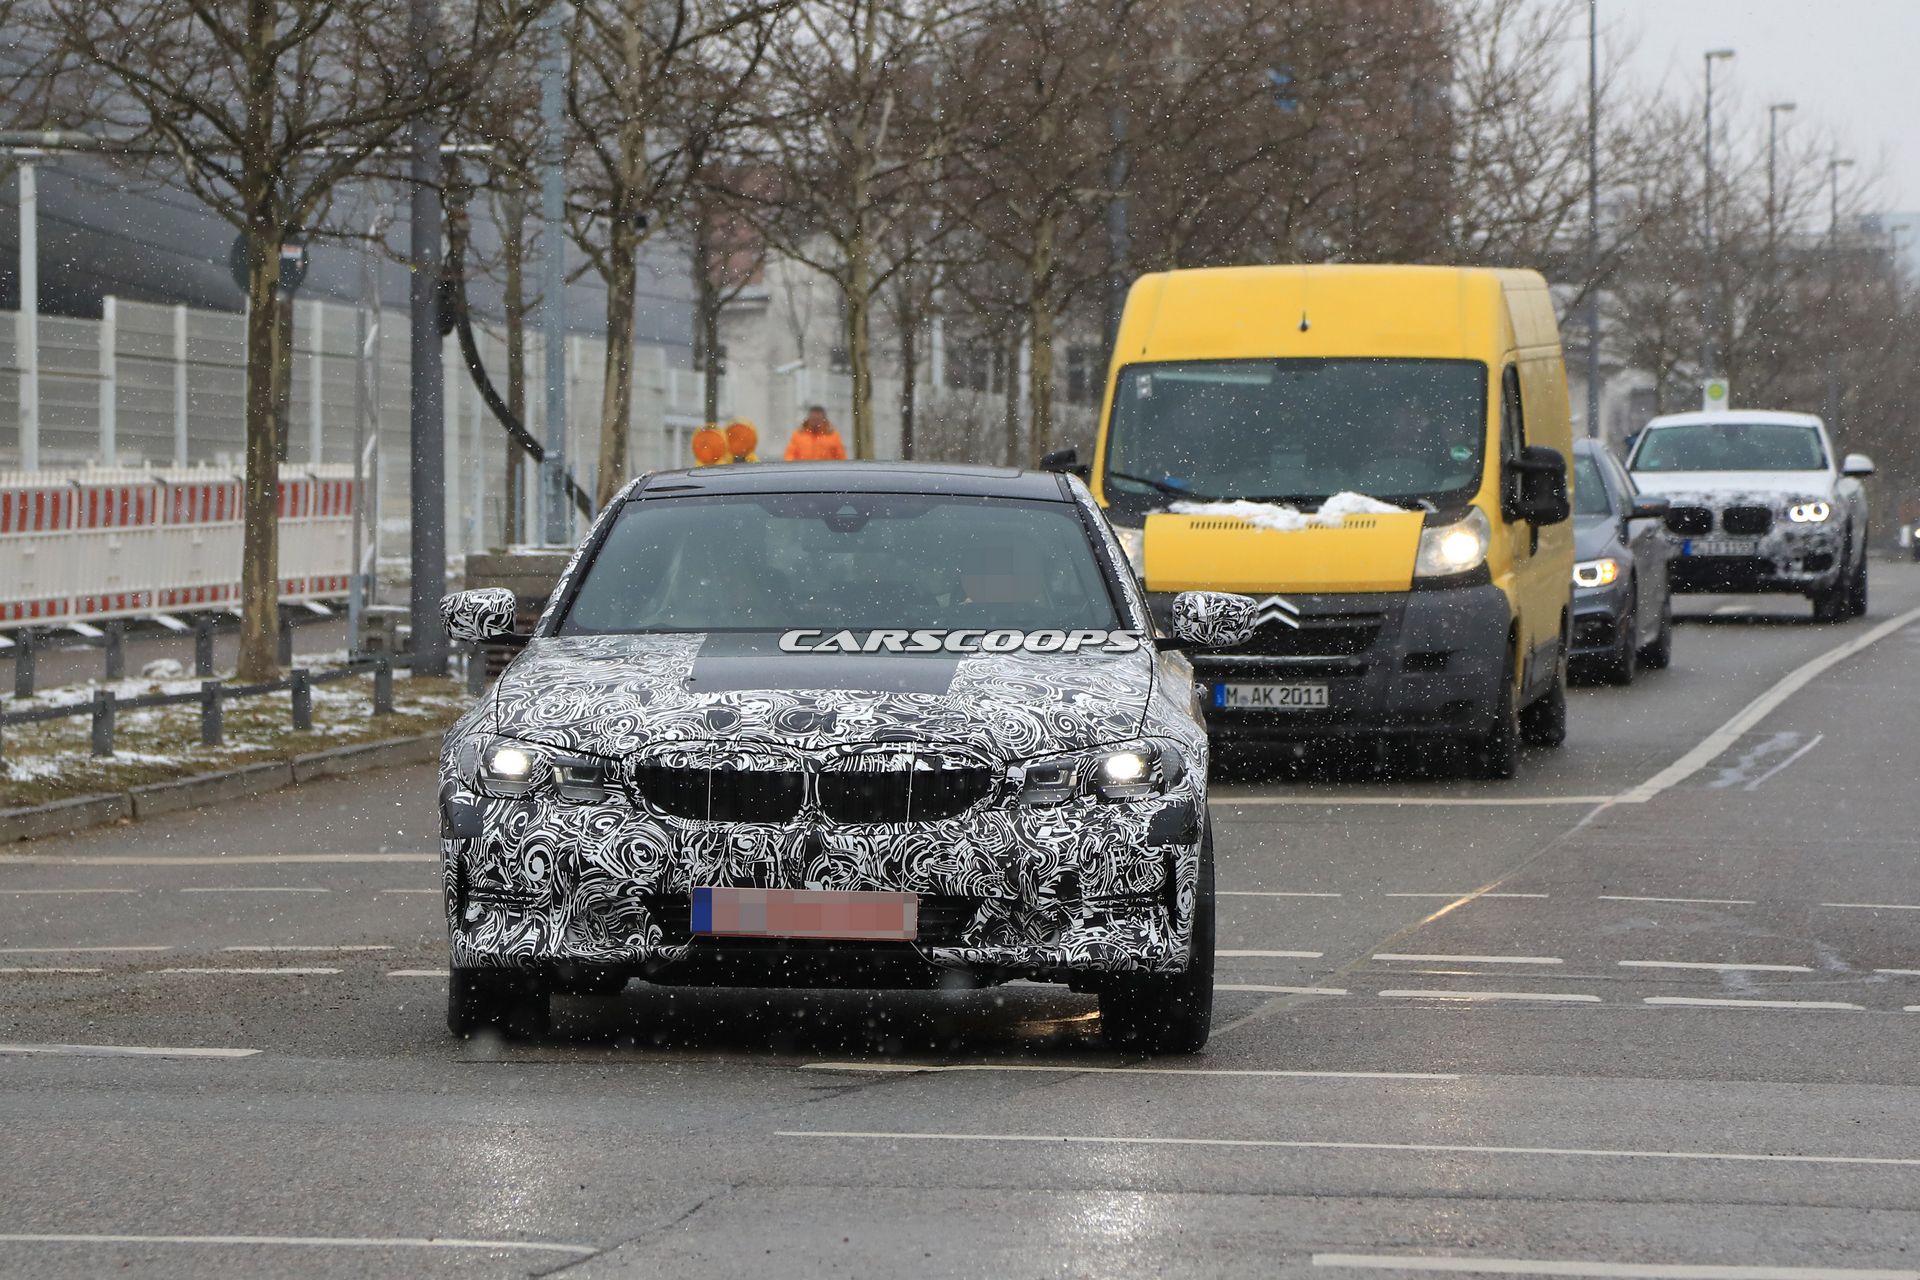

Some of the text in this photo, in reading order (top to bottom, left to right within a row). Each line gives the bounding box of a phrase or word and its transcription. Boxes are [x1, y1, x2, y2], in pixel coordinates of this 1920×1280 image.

[1226, 687, 1326, 706] M AK 2011
